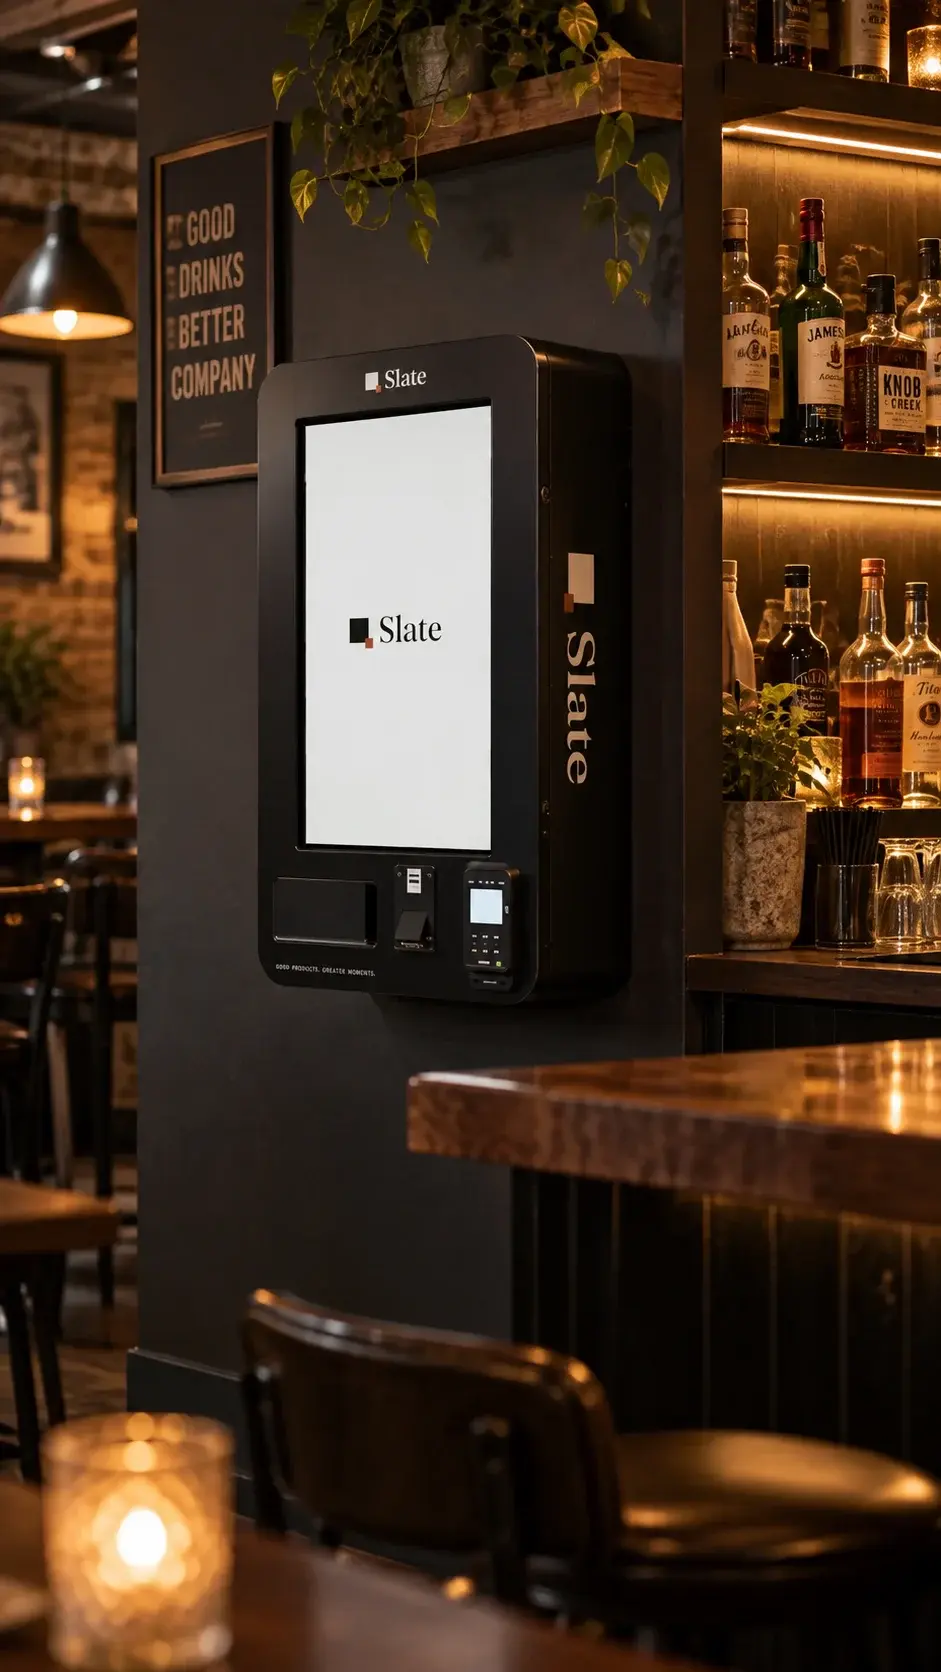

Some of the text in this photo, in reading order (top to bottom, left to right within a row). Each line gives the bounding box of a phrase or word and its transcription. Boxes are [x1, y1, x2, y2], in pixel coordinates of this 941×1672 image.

[187, 203, 235, 246] GOOD
[180, 252, 244, 298] DRINKS
[178, 304, 245, 349] BETTER
[171, 354, 256, 400] COMPANY
[384, 368, 427, 389] Slate
[884, 373, 921, 398] KNOB
[379, 614, 442, 643] Slate
[566, 631, 596, 784] Slate
